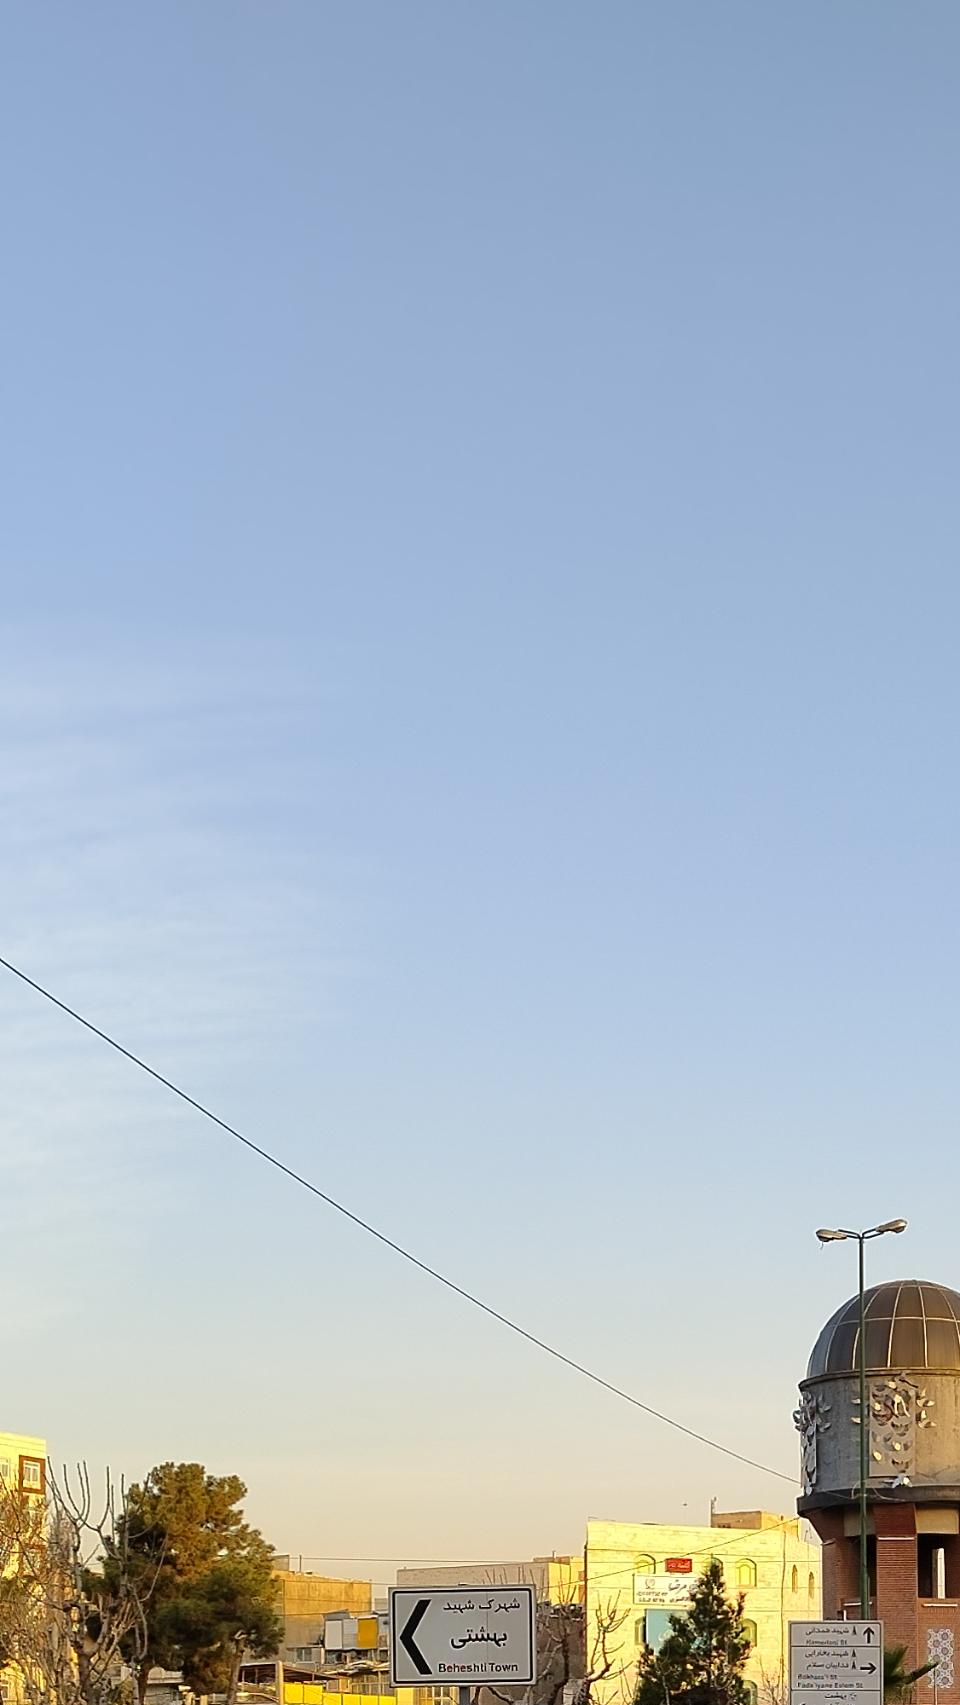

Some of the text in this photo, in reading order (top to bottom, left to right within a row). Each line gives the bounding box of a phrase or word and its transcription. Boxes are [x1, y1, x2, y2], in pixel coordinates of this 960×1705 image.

[443, 1598, 521, 1614] شهرک شهید
[450, 1626, 508, 1649] بهشتی
[438, 1663, 518, 1673] Beheshti Town
